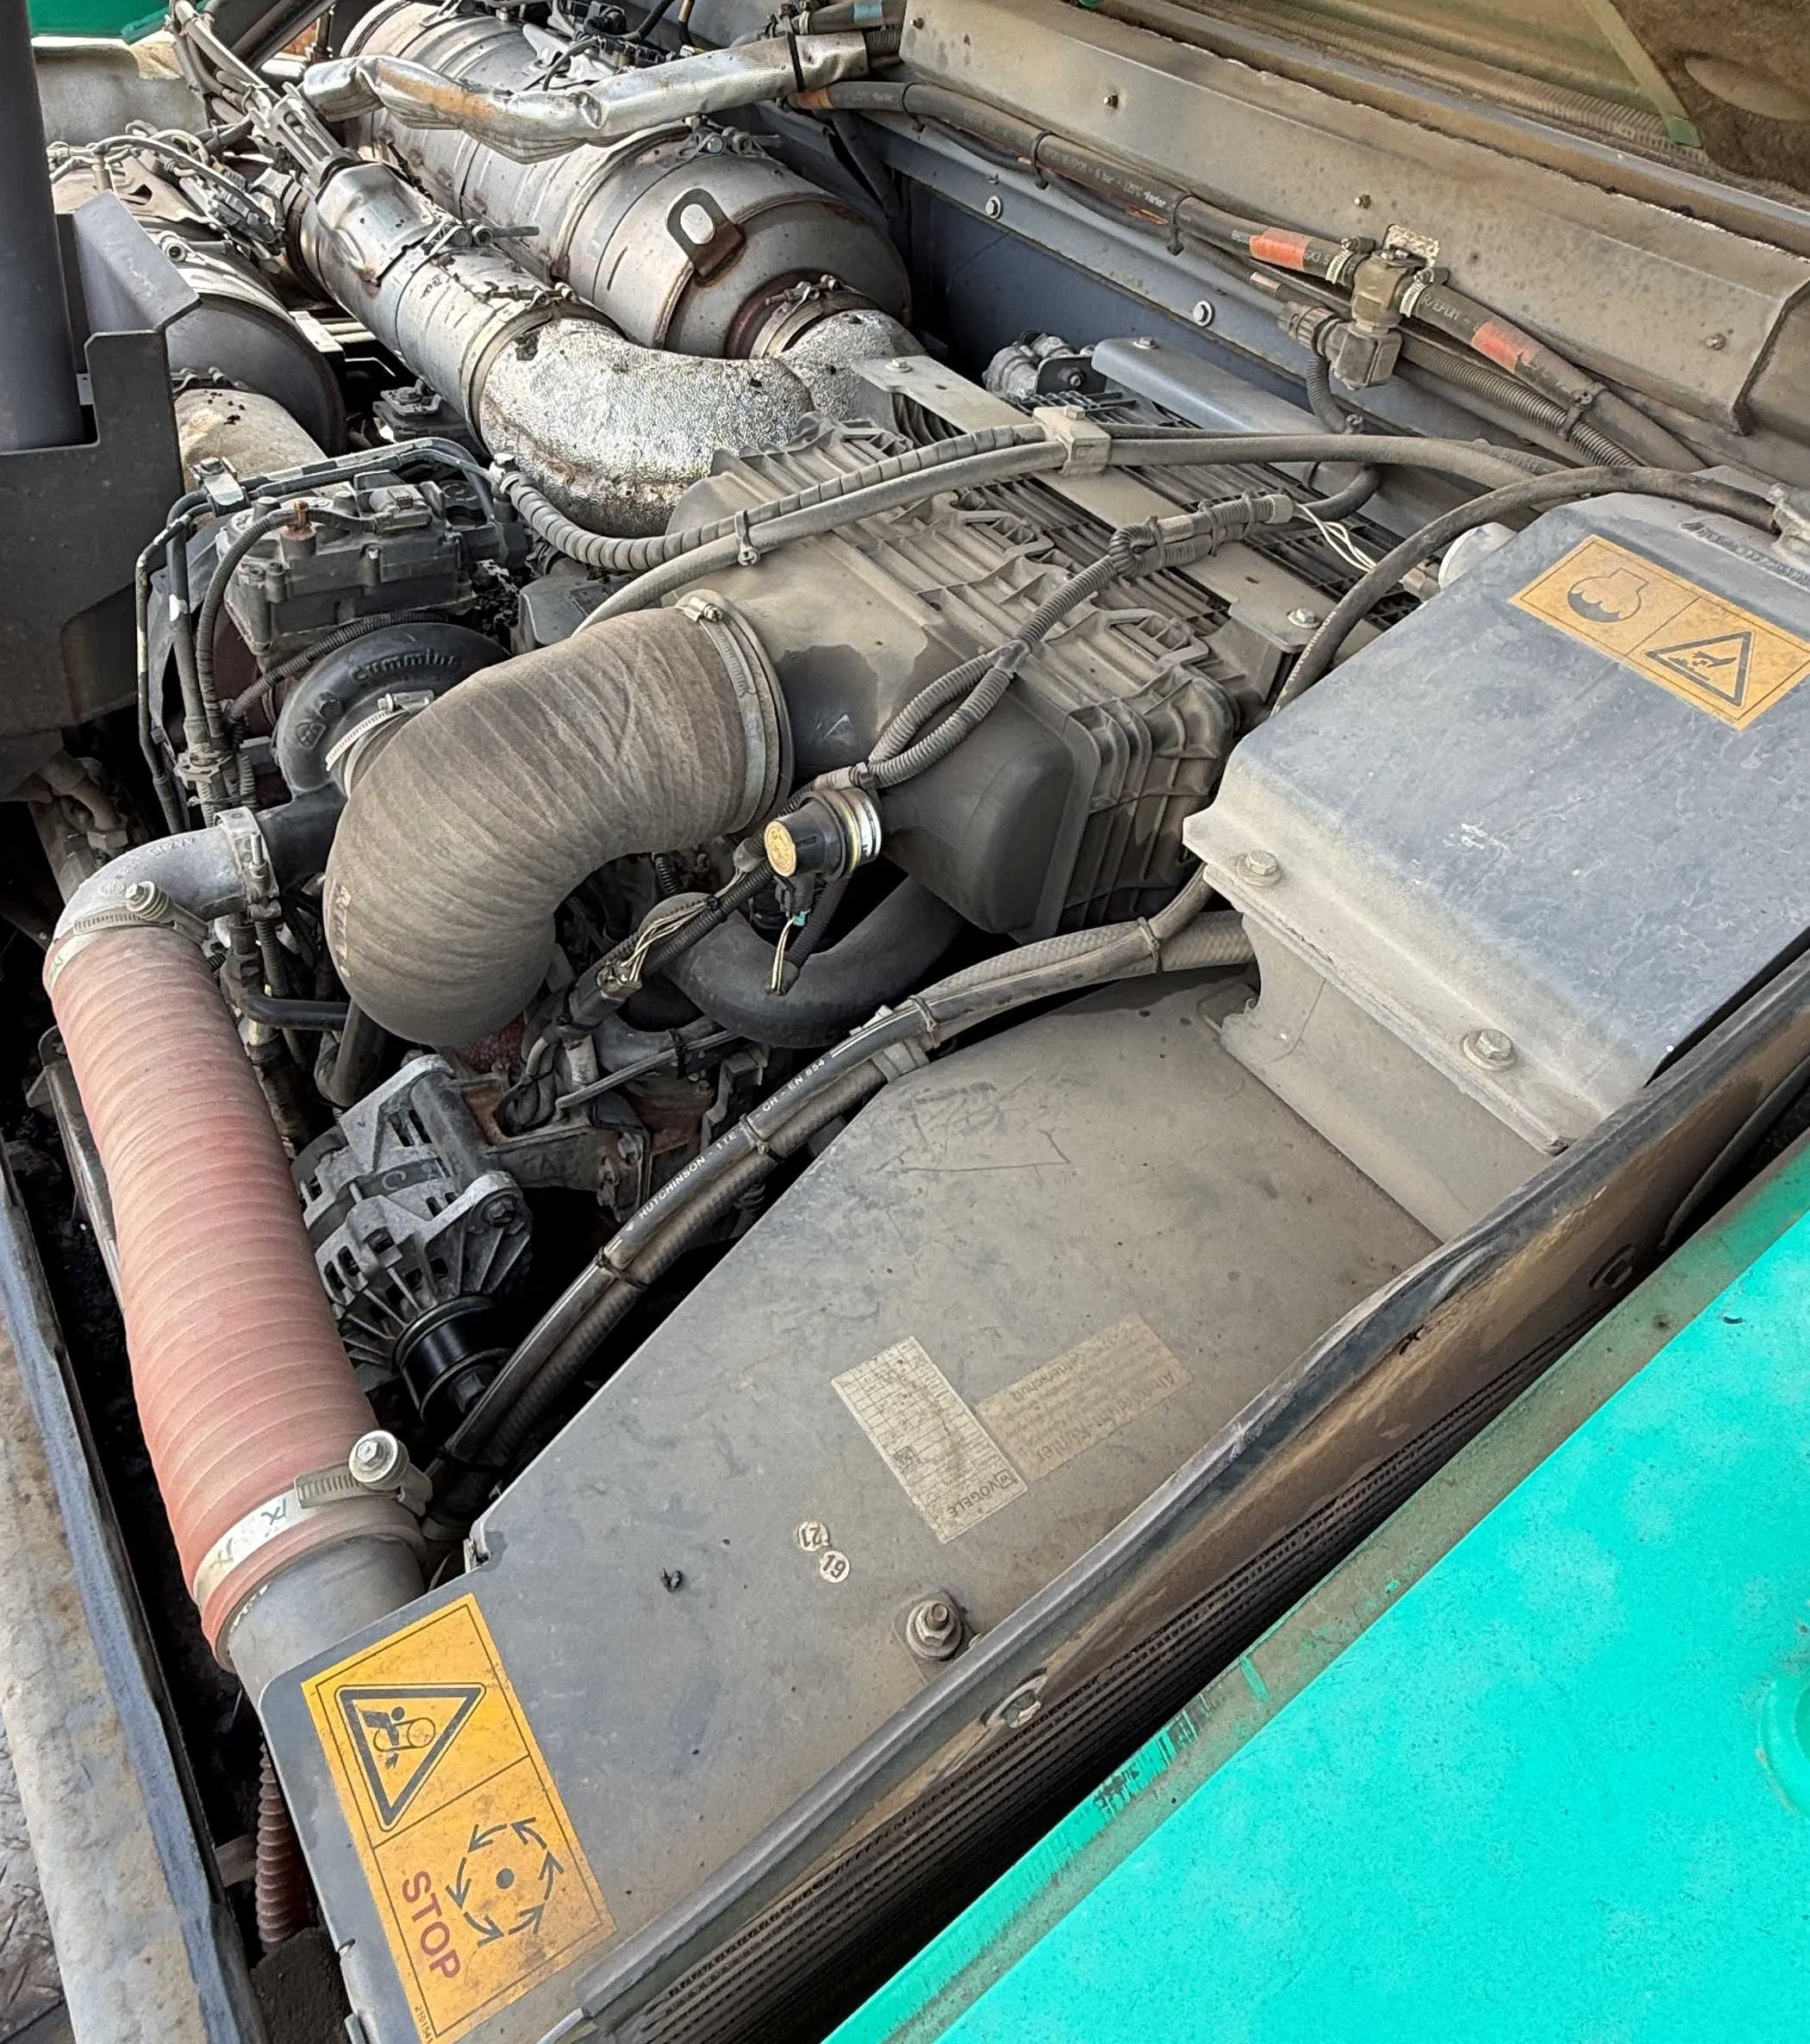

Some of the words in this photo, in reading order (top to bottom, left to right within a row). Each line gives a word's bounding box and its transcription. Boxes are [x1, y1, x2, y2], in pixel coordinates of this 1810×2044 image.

[638, 1156, 707, 1220] HUTCHINSON
[789, 1075, 805, 1091] EN
[947, 1480, 998, 1517] VÖGELE
[801, 1527, 822, 1548] 21
[822, 1554, 846, 1578] 19
[402, 1871, 461, 1979] STOP
